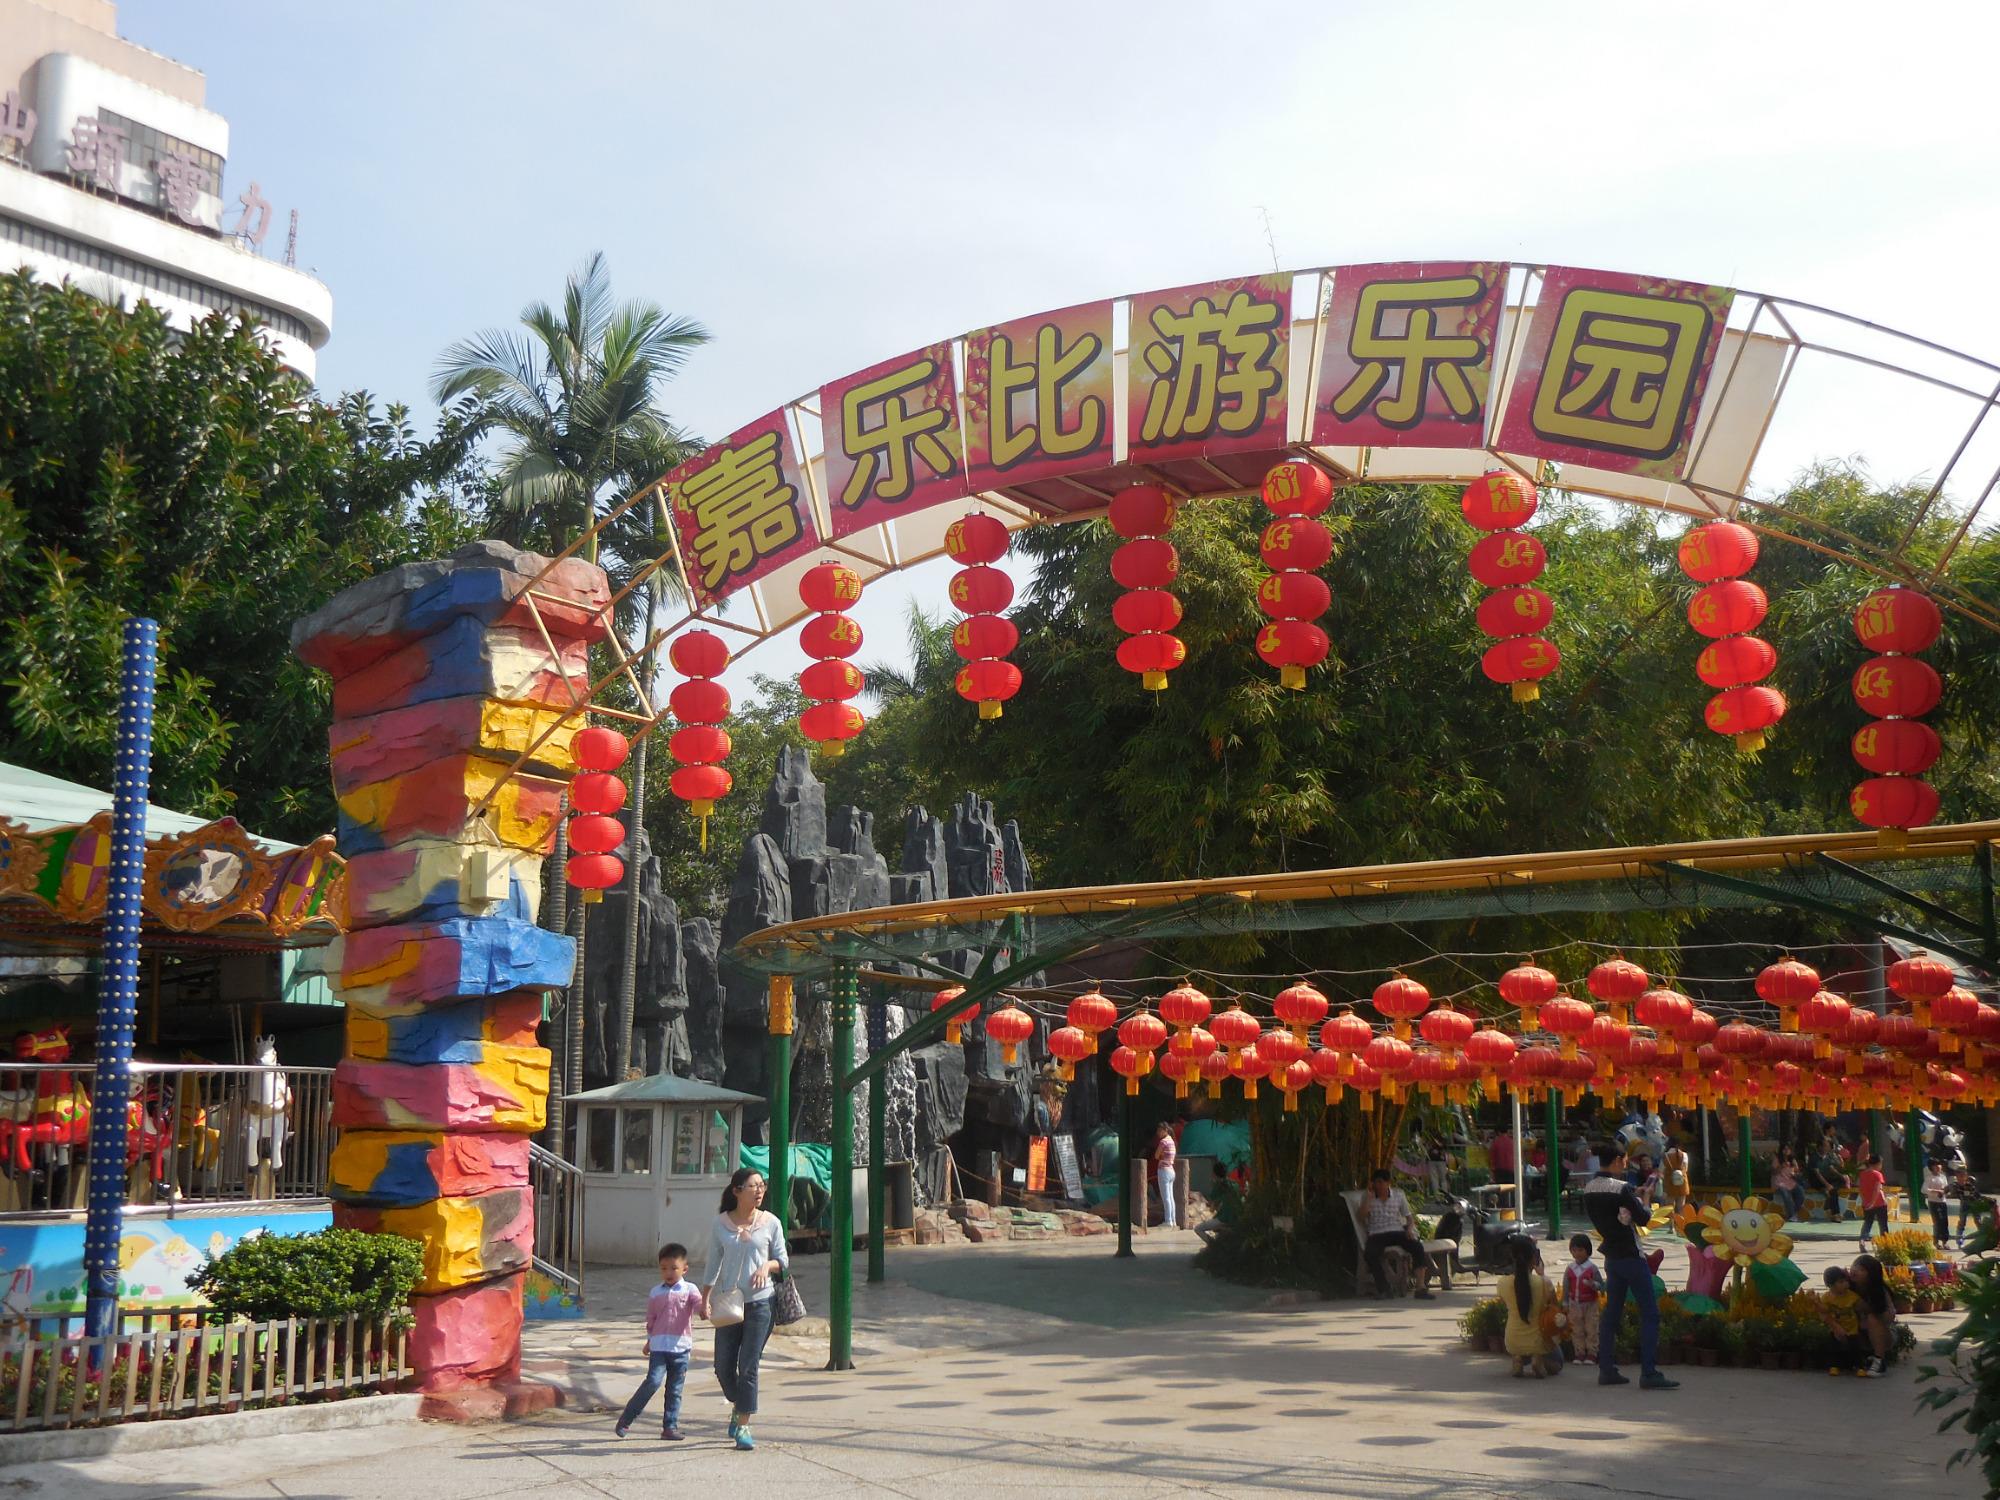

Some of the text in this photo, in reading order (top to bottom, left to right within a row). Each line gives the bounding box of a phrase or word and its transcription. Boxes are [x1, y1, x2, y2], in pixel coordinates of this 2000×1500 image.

[681, 275, 1713, 592] 嘉乐比游乐园
